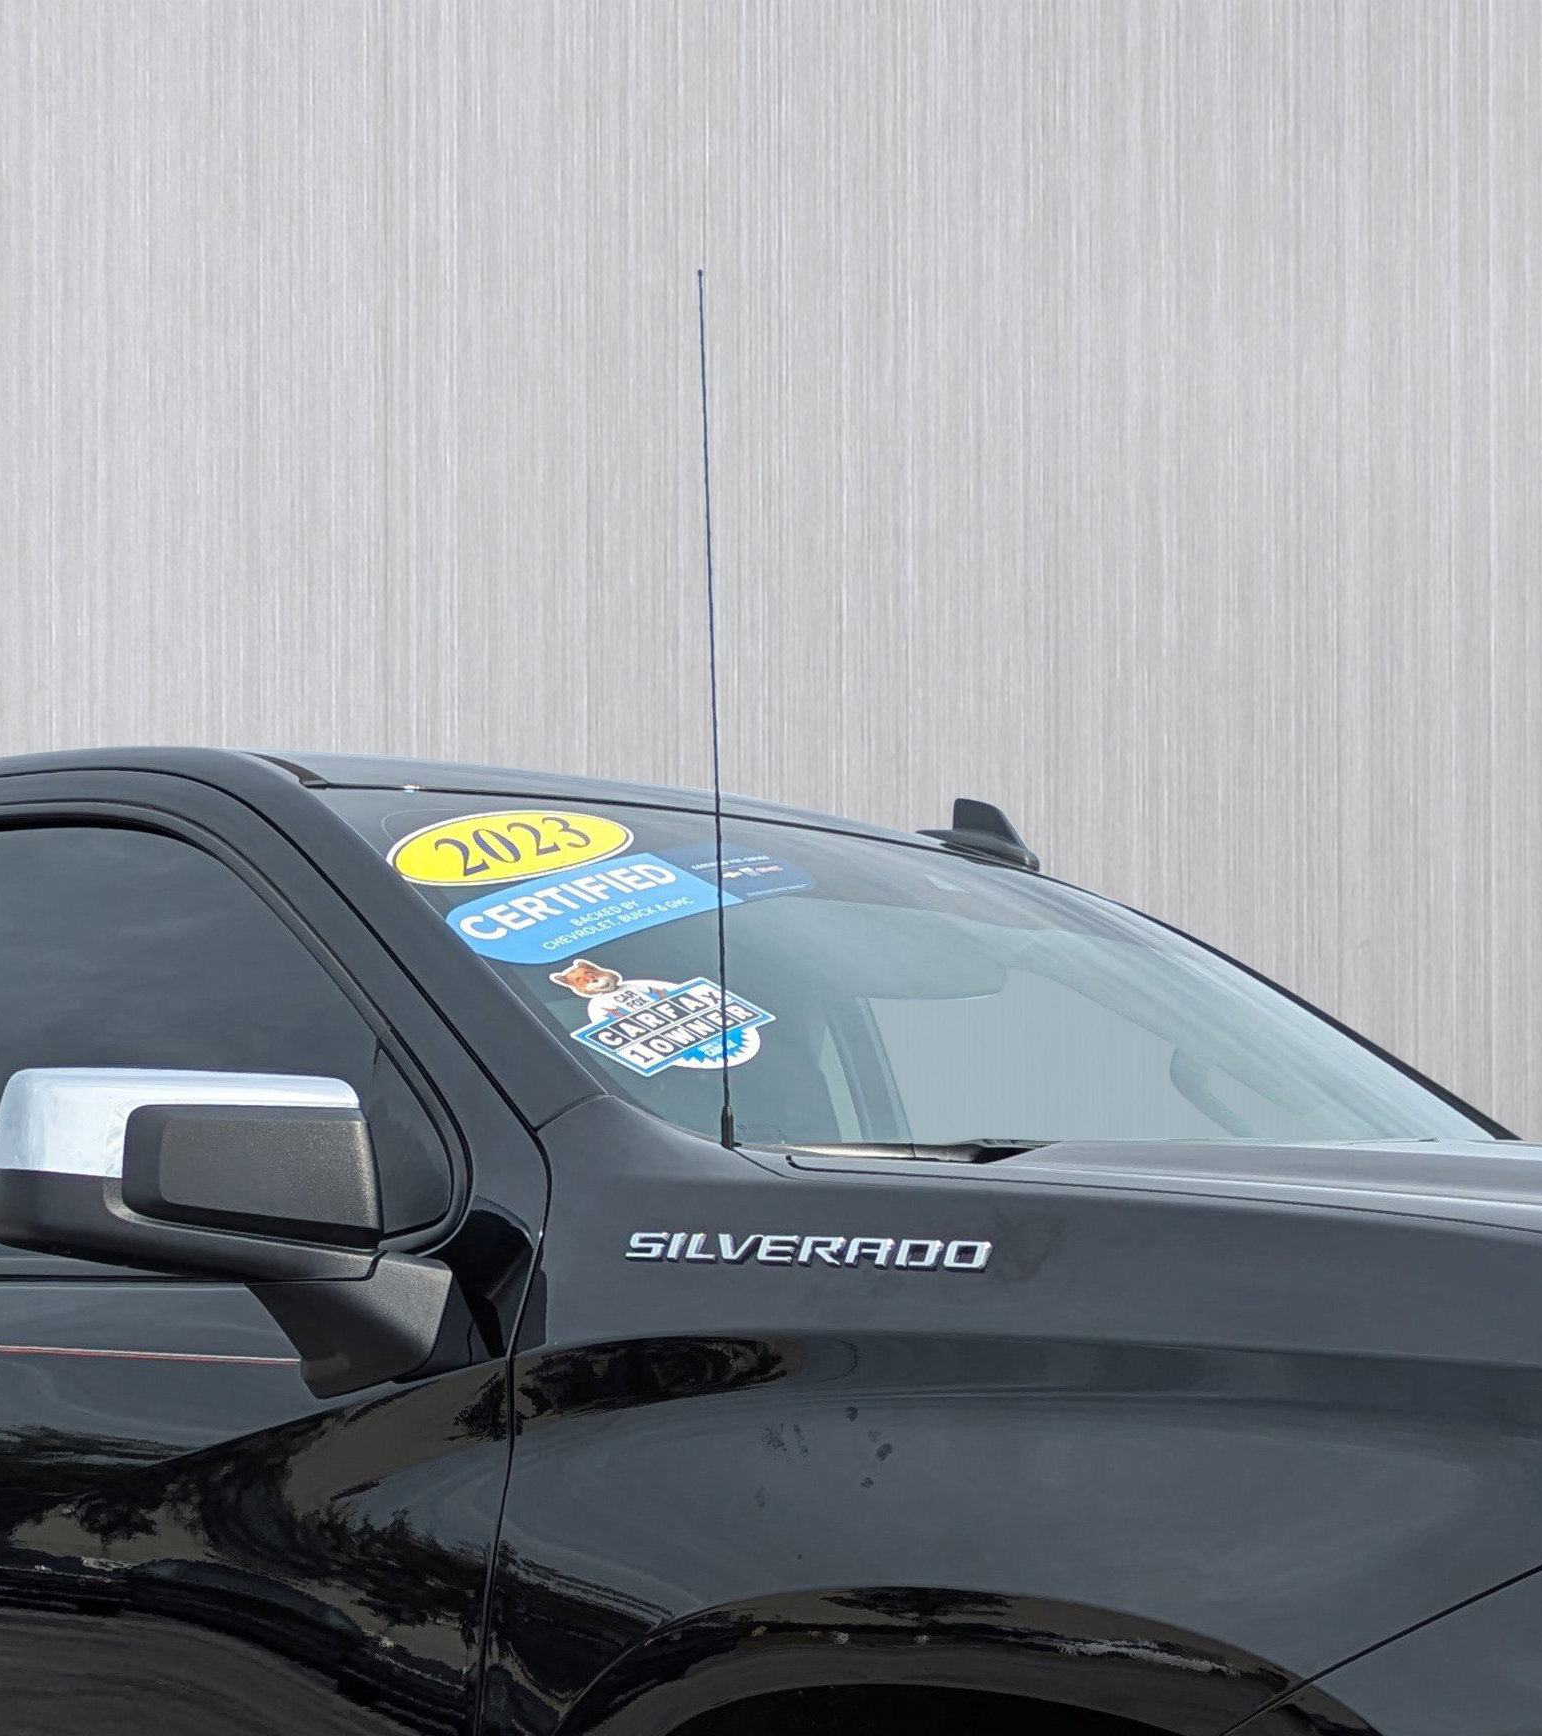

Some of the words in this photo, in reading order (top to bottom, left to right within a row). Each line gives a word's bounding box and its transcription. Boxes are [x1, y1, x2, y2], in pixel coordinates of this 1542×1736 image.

[434, 816, 591, 877] 2023
[459, 863, 678, 941] CERTIFIED
[569, 905, 622, 927] BACKED
[622, 899, 639, 912] BY
[623, 907, 654, 926] BUICK
[665, 896, 694, 910] GMC
[613, 990, 638, 1003] CAR
[625, 996, 650, 1010] FOX
[597, 990, 721, 1046] CARFAX
[630, 1048, 654, 1063] 1
[649, 1004, 754, 1053] OWNER
[625, 1231, 993, 1273] SILVERADO
